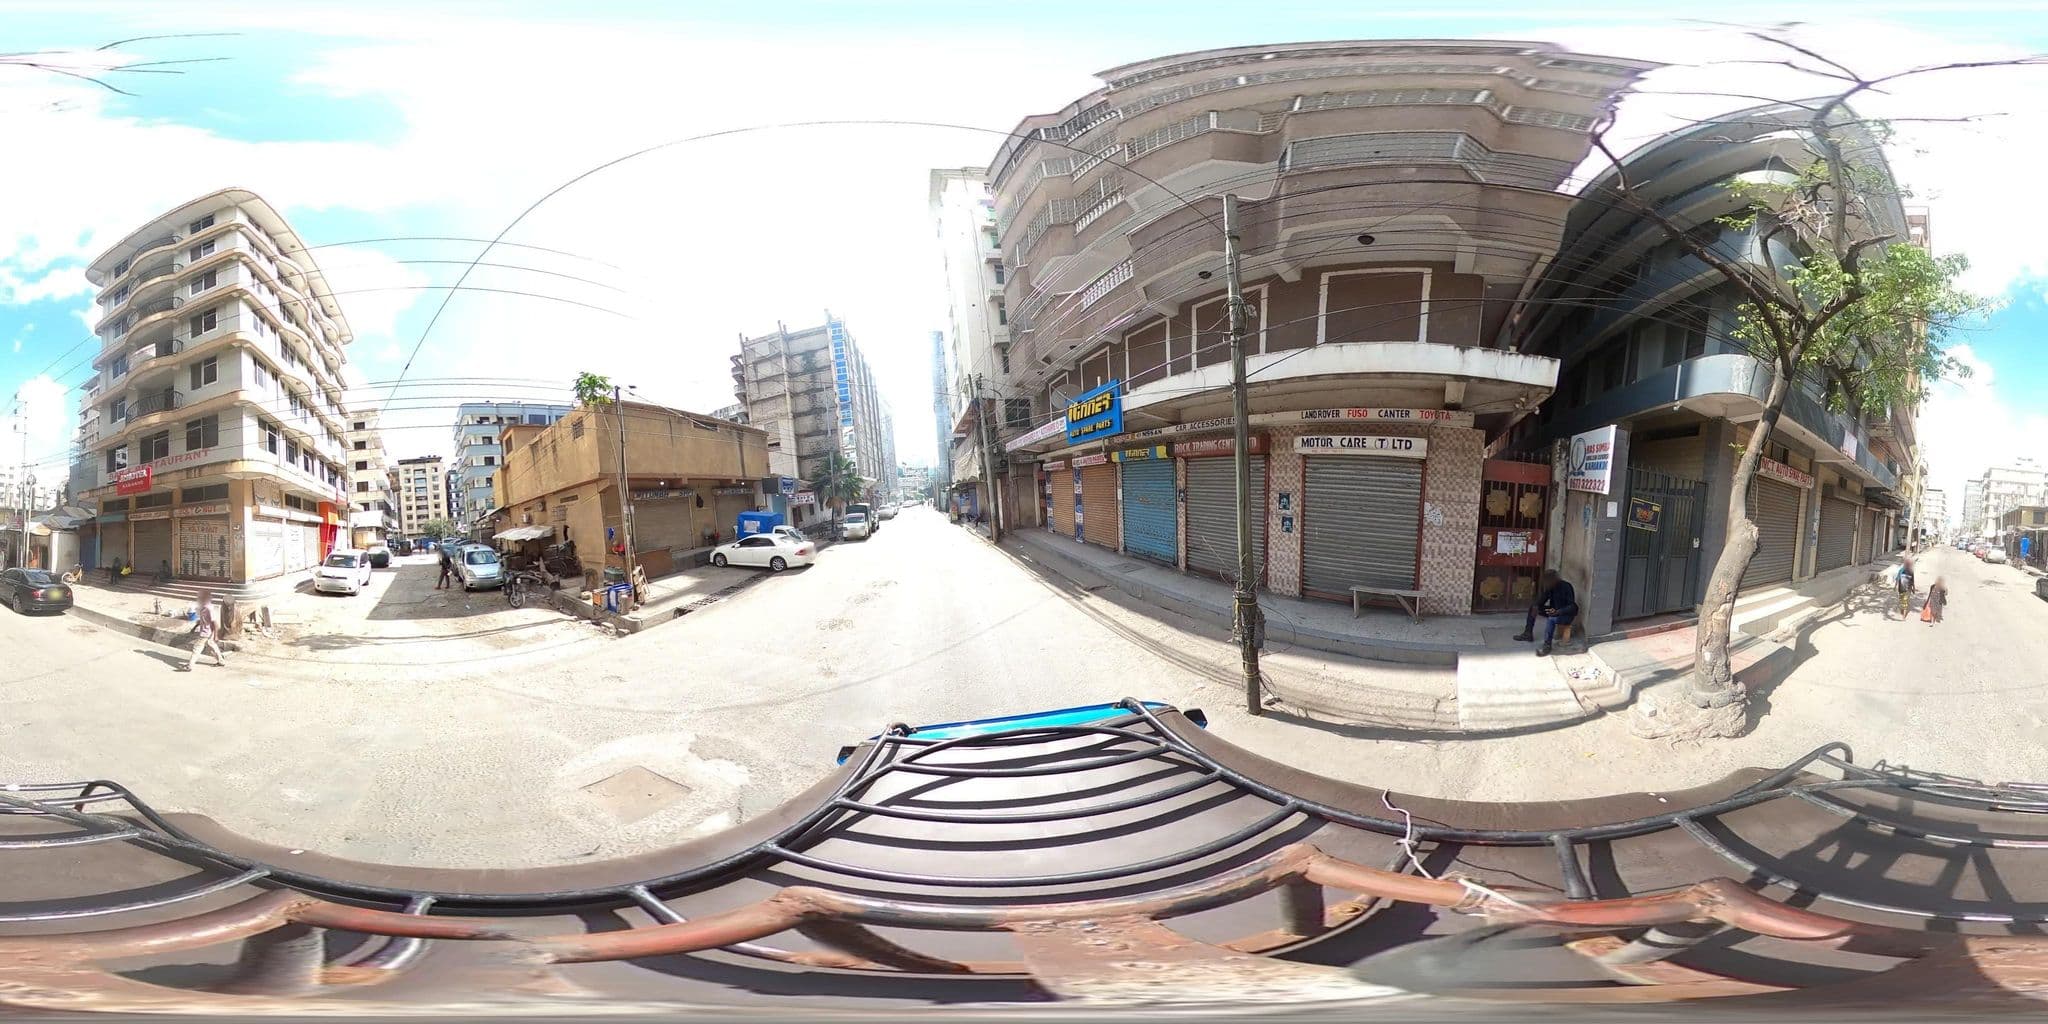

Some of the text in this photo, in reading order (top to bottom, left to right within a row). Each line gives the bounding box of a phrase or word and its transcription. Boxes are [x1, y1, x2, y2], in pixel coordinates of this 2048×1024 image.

[1347, 408, 1368, 418] FUSO
[1378, 409, 1410, 418] CANTER
[1419, 410, 1451, 420] TOYOTA
[1175, 424, 1187, 432] CAR
[1301, 437, 1413, 450] MOTOR CARE (T) LTD
